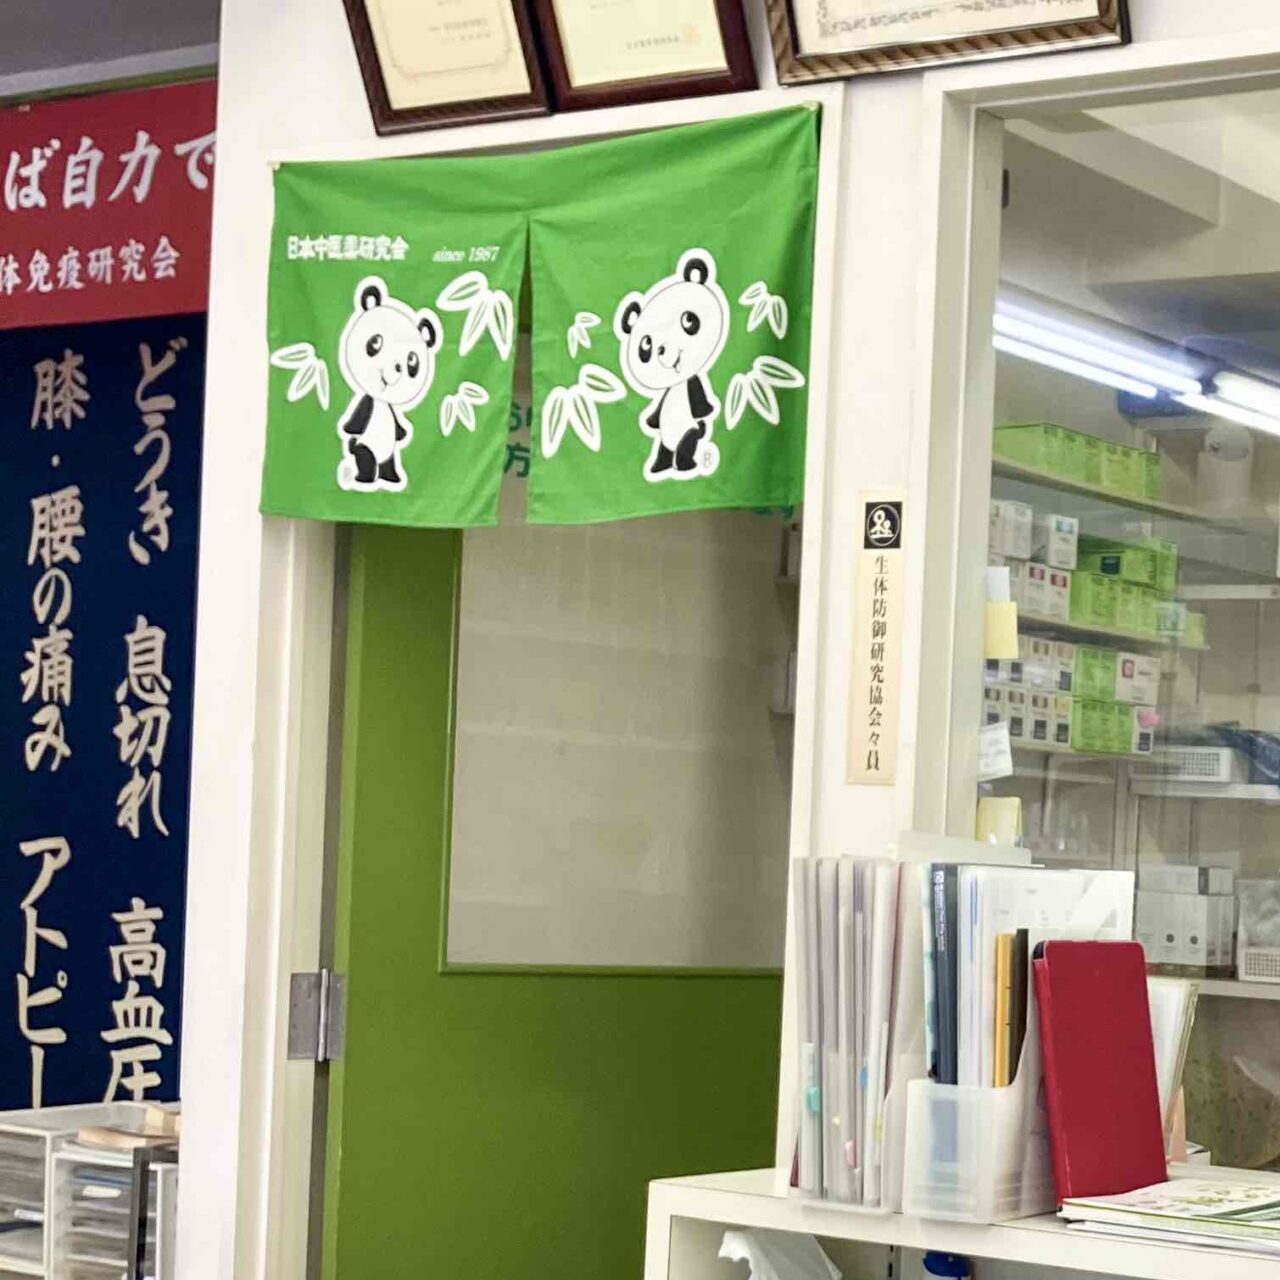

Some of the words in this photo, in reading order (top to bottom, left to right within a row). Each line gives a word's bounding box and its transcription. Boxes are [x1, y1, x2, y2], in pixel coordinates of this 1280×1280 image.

[433, 247, 463, 262] since
[20, 348, 92, 772] 膝・腰の痛み
[129, 336, 189, 564] どうき
[115, 615, 173, 838] 息切れ
[865, 554, 890, 771] 生体防御研究協会々員
[17, 836, 72, 1109] アトピー
